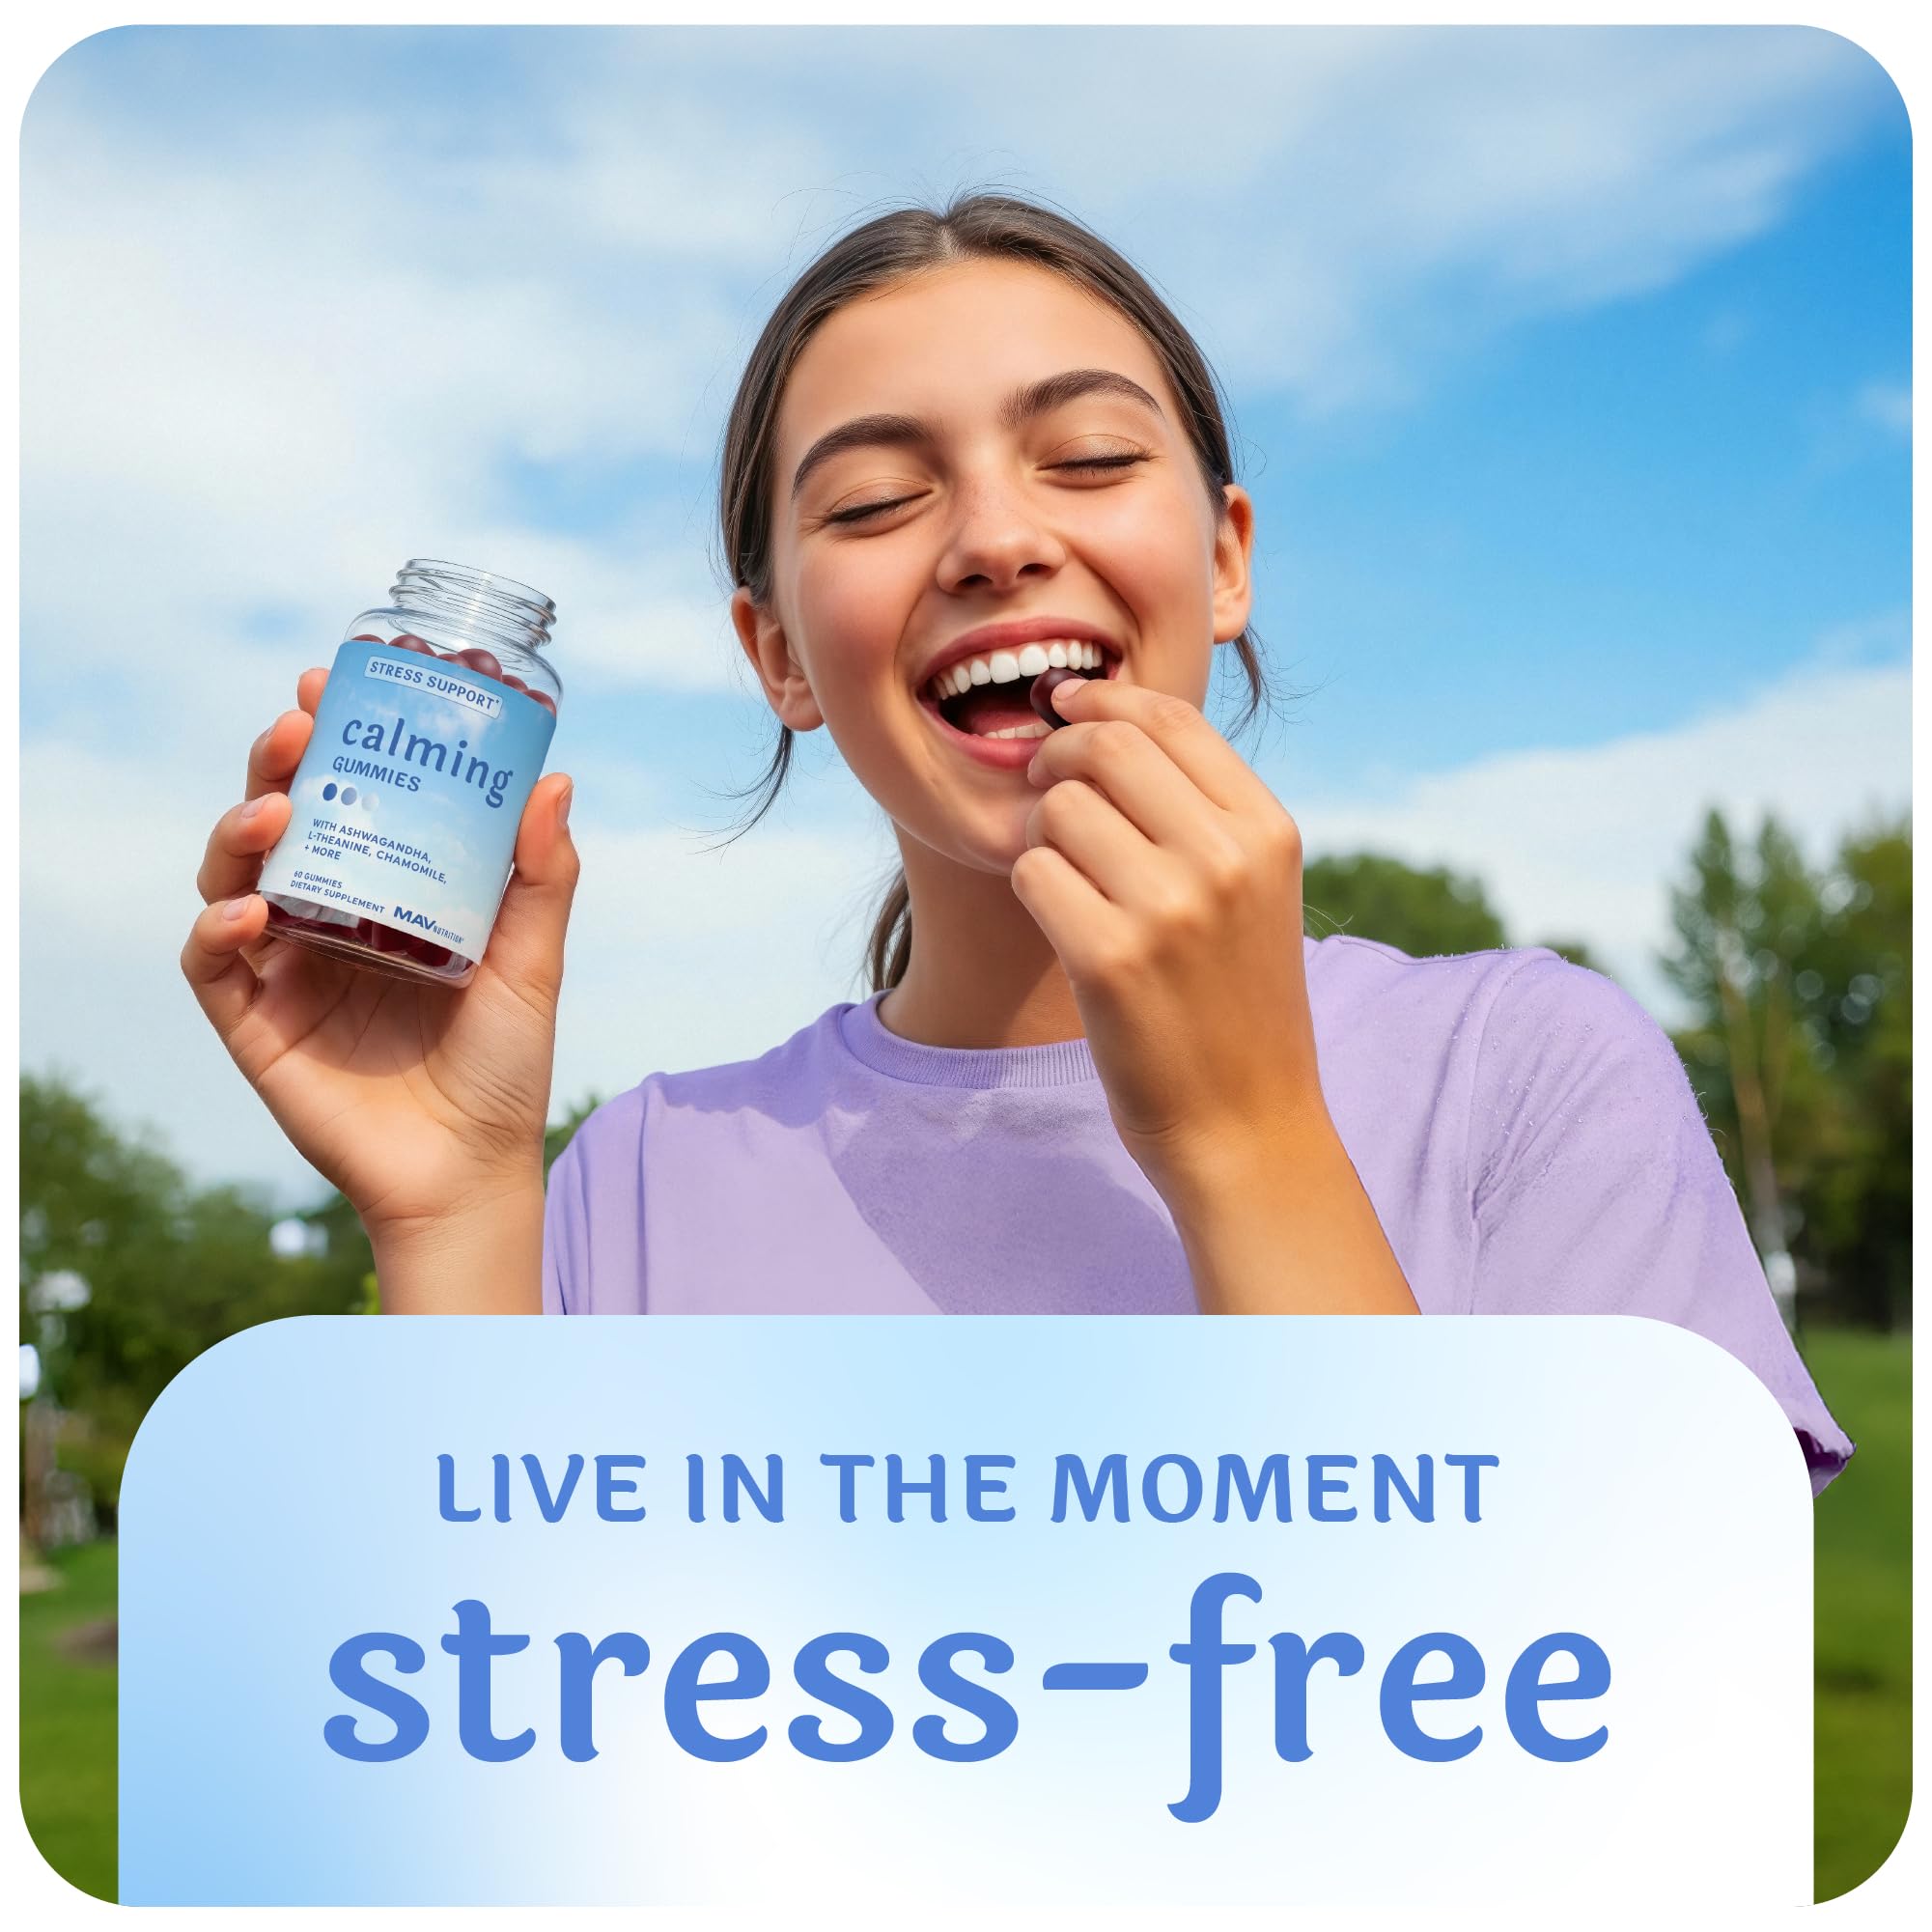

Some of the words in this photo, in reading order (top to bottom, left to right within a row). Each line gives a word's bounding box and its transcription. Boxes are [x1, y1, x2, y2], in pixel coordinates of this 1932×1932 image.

[370, 660, 424, 684] STRESS
[332, 756, 422, 792] GUMMIES
[342, 717, 514, 808] calming
[308, 830, 372, 856] L-THEANINE,
[376, 850, 447, 884] CHAMOMILE,
[311, 846, 342, 860] MORE
[312, 818, 338, 831] WITH
[339, 826, 432, 863] ASHWAGANDHA,
[294, 870, 303, 879] 60
[304, 872, 343, 888] GUMMIES
[290, 880, 322, 894] DIETARY
[323, 888, 385, 913] SUPPLEMENT
[393, 906, 436, 930] MAV
